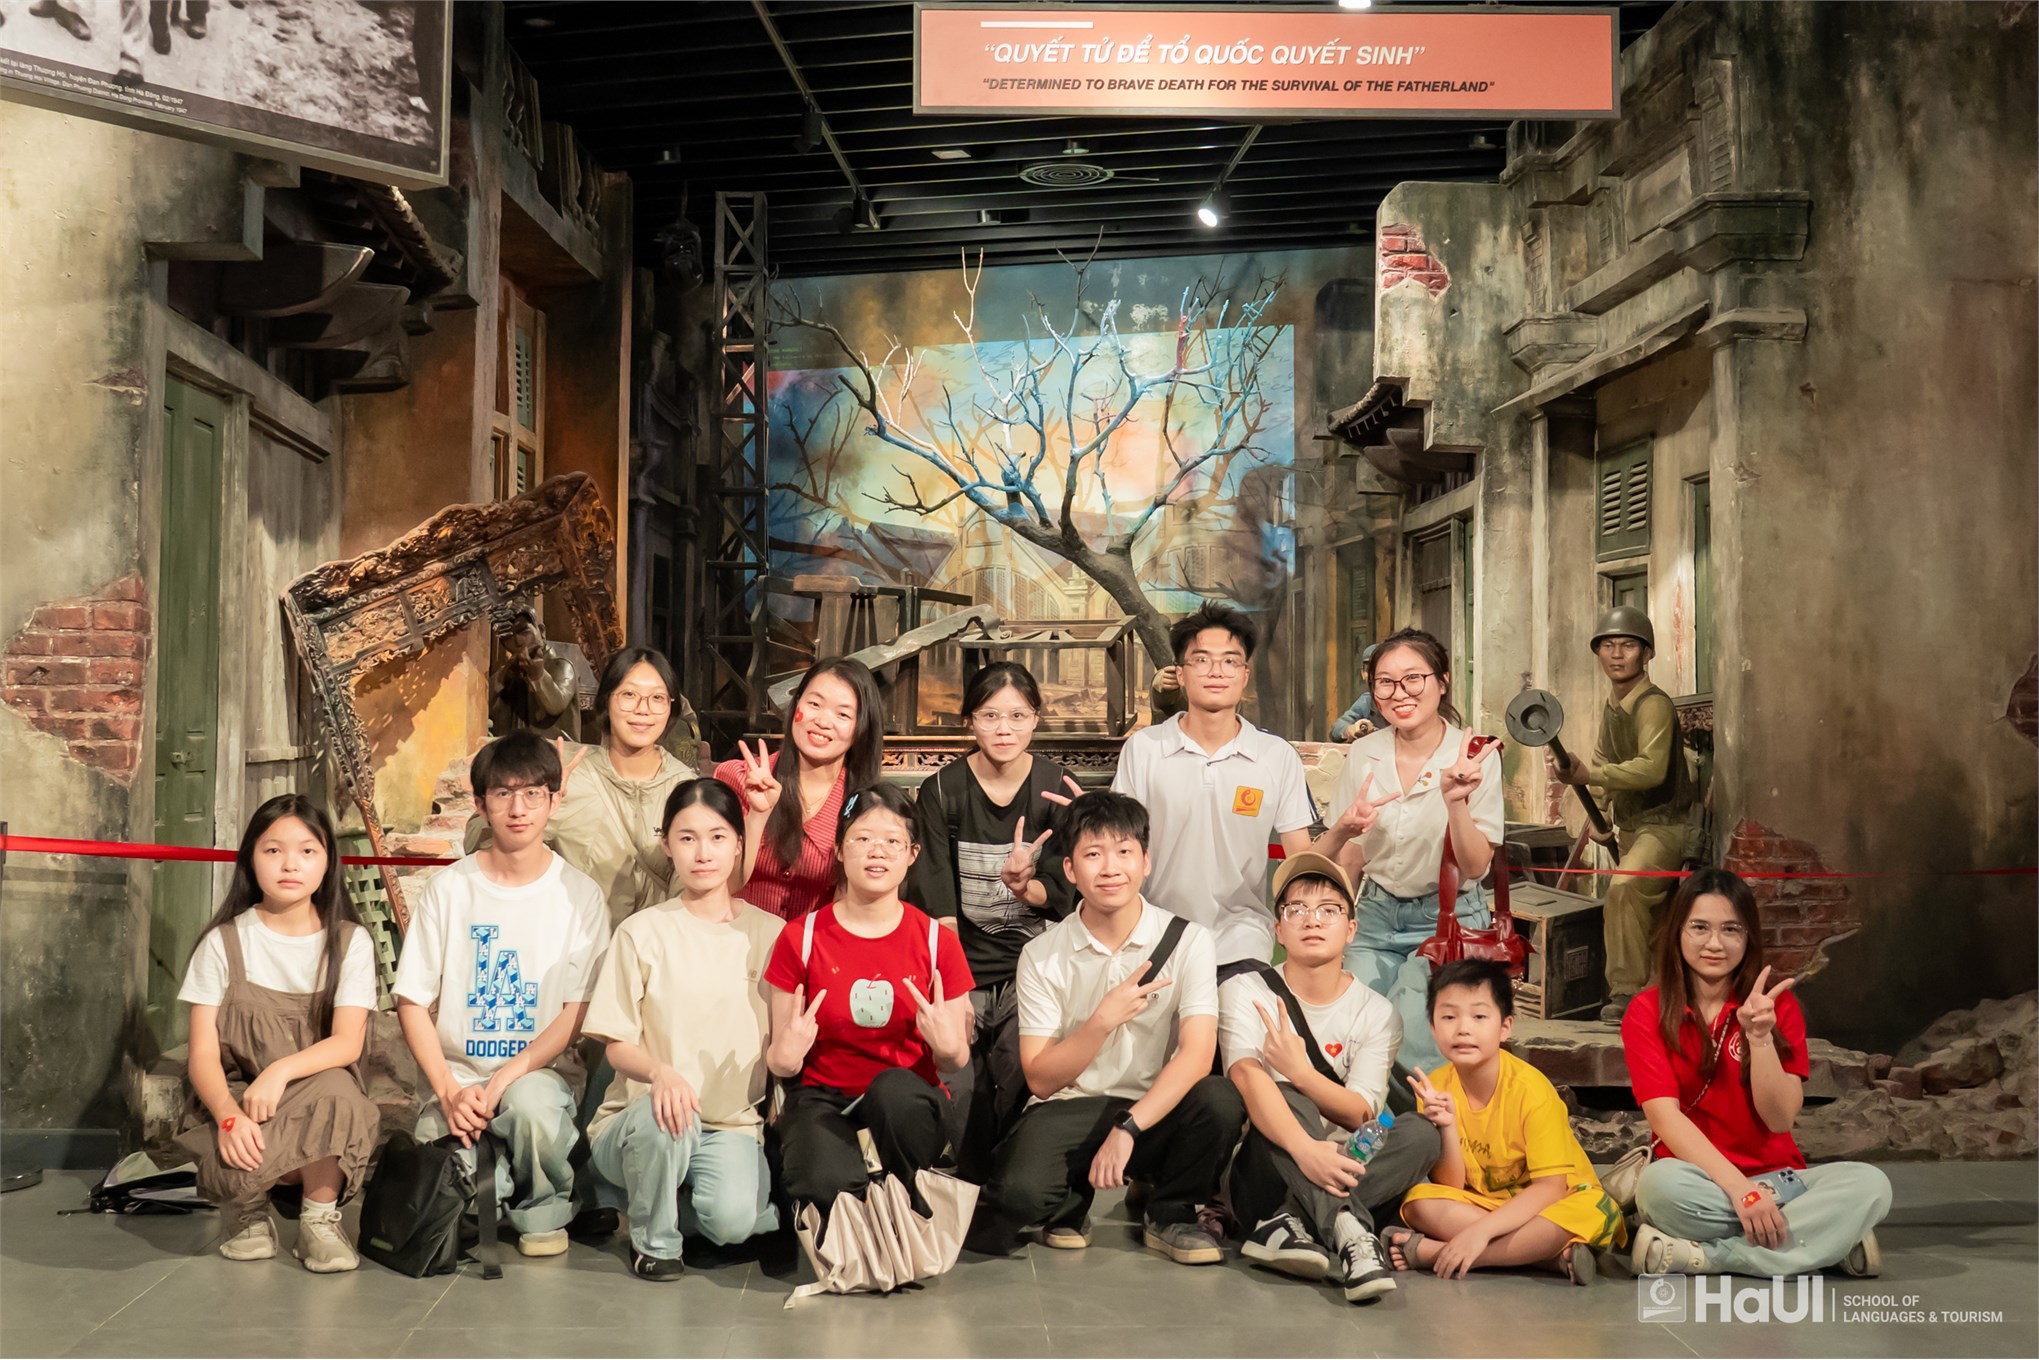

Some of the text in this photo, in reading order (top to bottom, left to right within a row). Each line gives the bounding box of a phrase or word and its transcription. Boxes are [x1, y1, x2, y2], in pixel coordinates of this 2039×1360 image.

[1082, 36, 1114, 63] TỬ
[1117, 34, 1153, 63] ĐỂ
[1158, 34, 1191, 64] TỔ
[1194, 38, 1264, 65] QUỐC
[1271, 38, 1351, 65] QUYẾT
[1086, 78, 1104, 90] TO
[1107, 79, 1155, 90] BRAVE
[1158, 79, 1204, 90] DEATH
[1208, 80, 1236, 91] FOR
[1242, 80, 1268, 91] THE
[1271, 80, 1339, 92] SURVIVAL
[1343, 81, 1363, 92] OF
[1367, 81, 1393, 92] THE
[467, 925, 538, 1032] LA
[466, 1040, 533, 1057] DODGER
